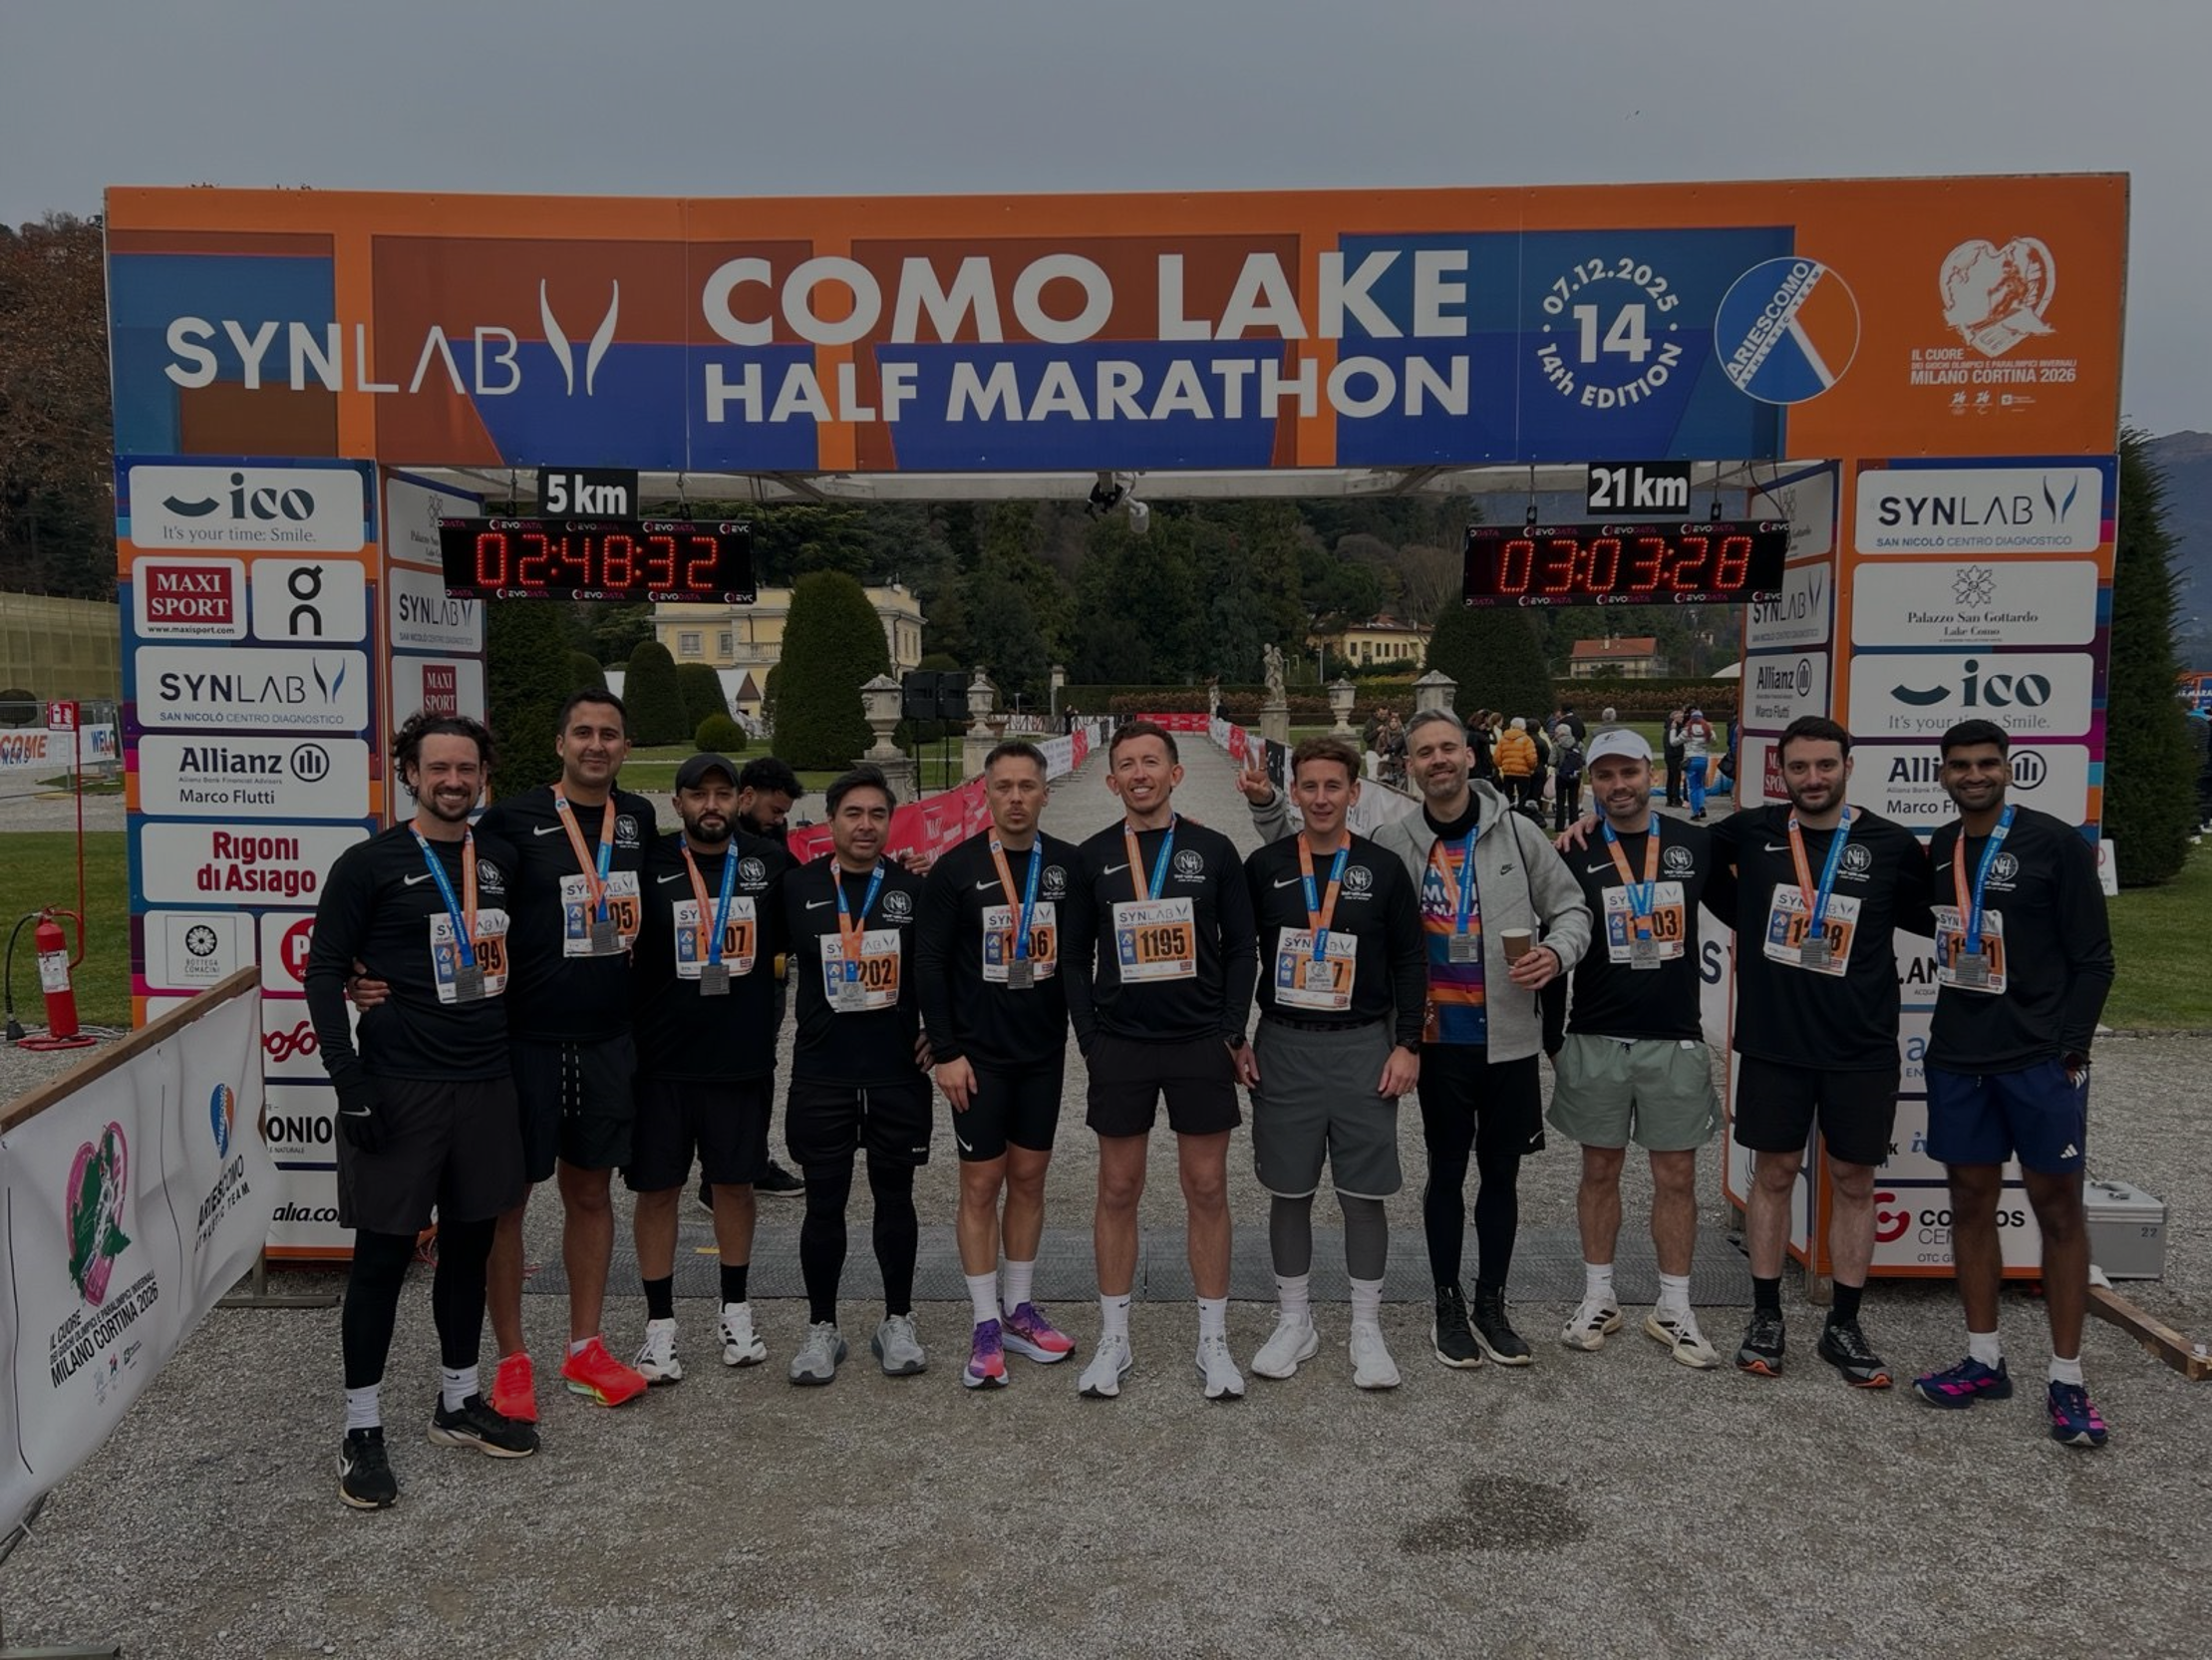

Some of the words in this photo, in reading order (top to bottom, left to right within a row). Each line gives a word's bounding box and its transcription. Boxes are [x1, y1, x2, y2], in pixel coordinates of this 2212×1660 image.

[702, 253, 1113, 346] COMO
[1157, 249, 1469, 341] LAKE
[1543, 257, 1680, 314] 07.12.2025
[1573, 303, 1653, 364] 14
[1727, 261, 1810, 380] ARIESCOMO
[1741, 316, 1790, 384] ATHLETIC
[1793, 270, 1820, 306] TEAM
[163, 316, 520, 395] SYNLAB
[1911, 349, 1922, 361] IL
[1925, 348, 1965, 361] CUORE
[1537, 342, 1574, 396] 14th
[1580, 342, 1683, 409] EDITION
[1910, 370, 1969, 385] MILANO
[1972, 368, 2037, 384] CORTINA
[2040, 368, 2077, 383] 2026
[704, 362, 919, 424] HALF
[946, 355, 1469, 423] MARATHON
[229, 472, 315, 520] ico
[546, 474, 568, 513] 5
[574, 474, 628, 514] km
[1589, 467, 1626, 507] 21
[1633, 467, 1688, 506] km
[1879, 496, 2034, 526] SYNLAB
[163, 525, 184, 539] It's
[189, 529, 224, 543] your
[229, 526, 267, 541] time:
[271, 527, 317, 543] Smile.
[1877, 537, 1899, 547] SAN
[1946, 536, 1992, 546] CENTRO
[1995, 535, 2072, 546] DIAGNOSTICO
[475, 532, 718, 588] 02:48:32
[1499, 536, 1753, 593] 03:03:28
[156, 573, 221, 593] MAXI
[151, 597, 229, 617] SPORT
[400, 592, 458, 626] SYNLAB
[1907, 612, 1954, 624] Palazzo
[1957, 612, 1981, 623] San
[1984, 610, 2039, 623] Gottardo
[148, 625, 235, 635] www.maxisport.com
[1944, 627, 1967, 636] Lake
[1970, 627, 2000, 636] Como
[159, 673, 306, 704] SYNLAB
[427, 671, 453, 689] MAXI
[1756, 666, 1794, 689] Allianz
[1959, 659, 2052, 707] ico
[425, 693, 456, 711] SPORT
[160, 712, 181, 721] SAN
[226, 713, 269, 723] CENTRO
[272, 714, 344, 724] DIAGNOSTICO
[1889, 715, 1910, 729] It's
[1917, 718, 1954, 733] your
[2002, 714, 2051, 729] Smile.
[178, 747, 283, 774] Allianz
[1888, 757, 1940, 783] Alli
[179, 789, 229, 804] Marco
[233, 790, 275, 805] Flutti
[1887, 800, 1938, 814] Marco
[212, 831, 299, 865] Rigoni
[197, 864, 221, 890] di
[225, 864, 316, 898] Asiago
[567, 882, 622, 896] SYAB
[437, 920, 492, 936] SYAB
[1119, 908, 1174, 923] SYNLAB
[827, 942, 882, 954] SYAB
[1140, 928, 1185, 957] 1195
[197, 1155, 244, 1231] ARIESCOMO
[227, 1181, 250, 1209] TEAM
[273, 1203, 340, 1222] alia.co
[2141, 1227, 2158, 1238] 22
[1917, 1253, 1940, 1263] OTC
[51, 1337, 96, 1389] MILANO
[93, 1300, 140, 1350] CORTINA
[137, 1281, 158, 1314] 2026
[57, 1309, 82, 1344] CUORE
